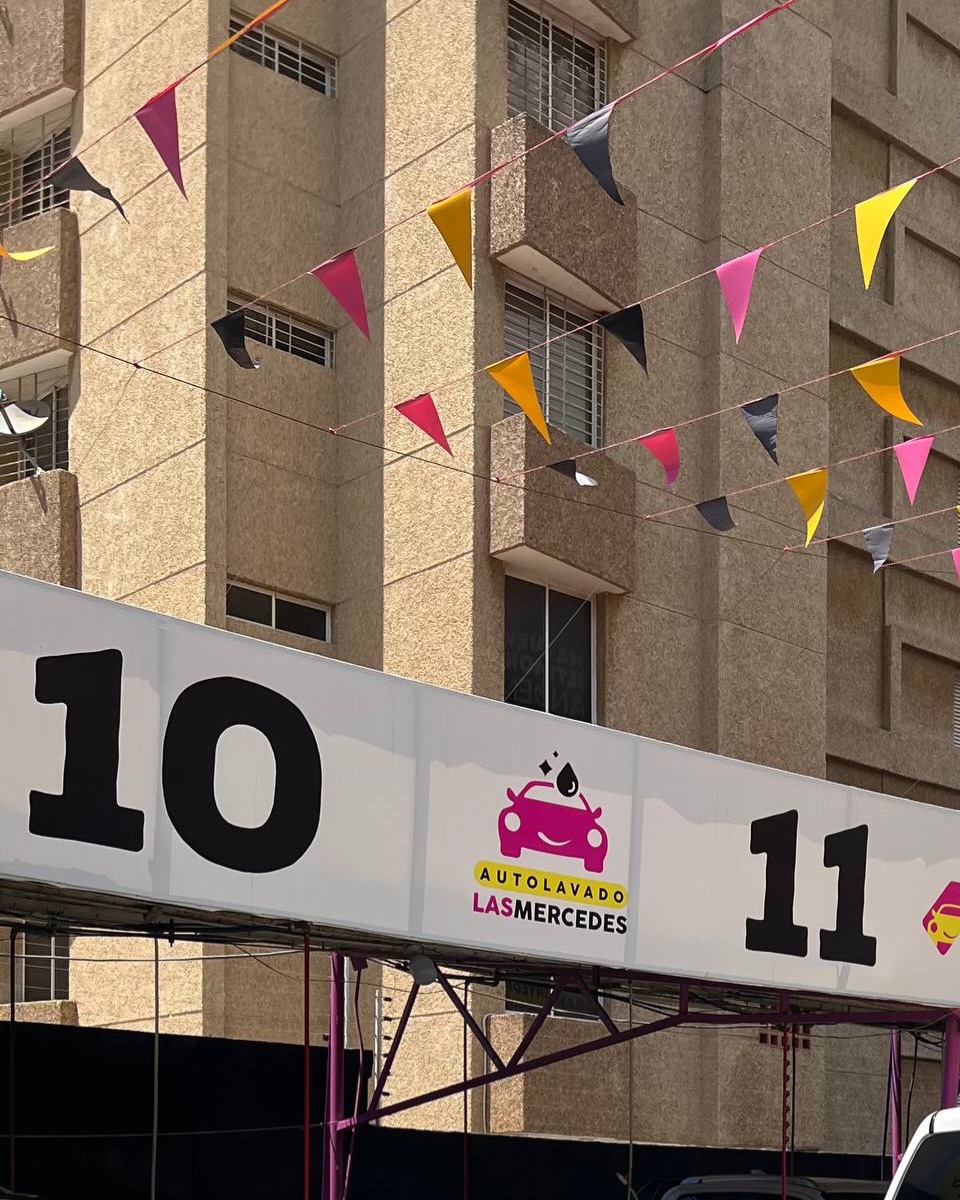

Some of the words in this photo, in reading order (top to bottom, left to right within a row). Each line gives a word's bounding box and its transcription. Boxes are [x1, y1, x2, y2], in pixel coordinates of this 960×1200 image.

[28, 648, 322, 873] 10
[480, 867, 624, 904] AUTOLAVADO
[745, 809, 876, 967] 11
